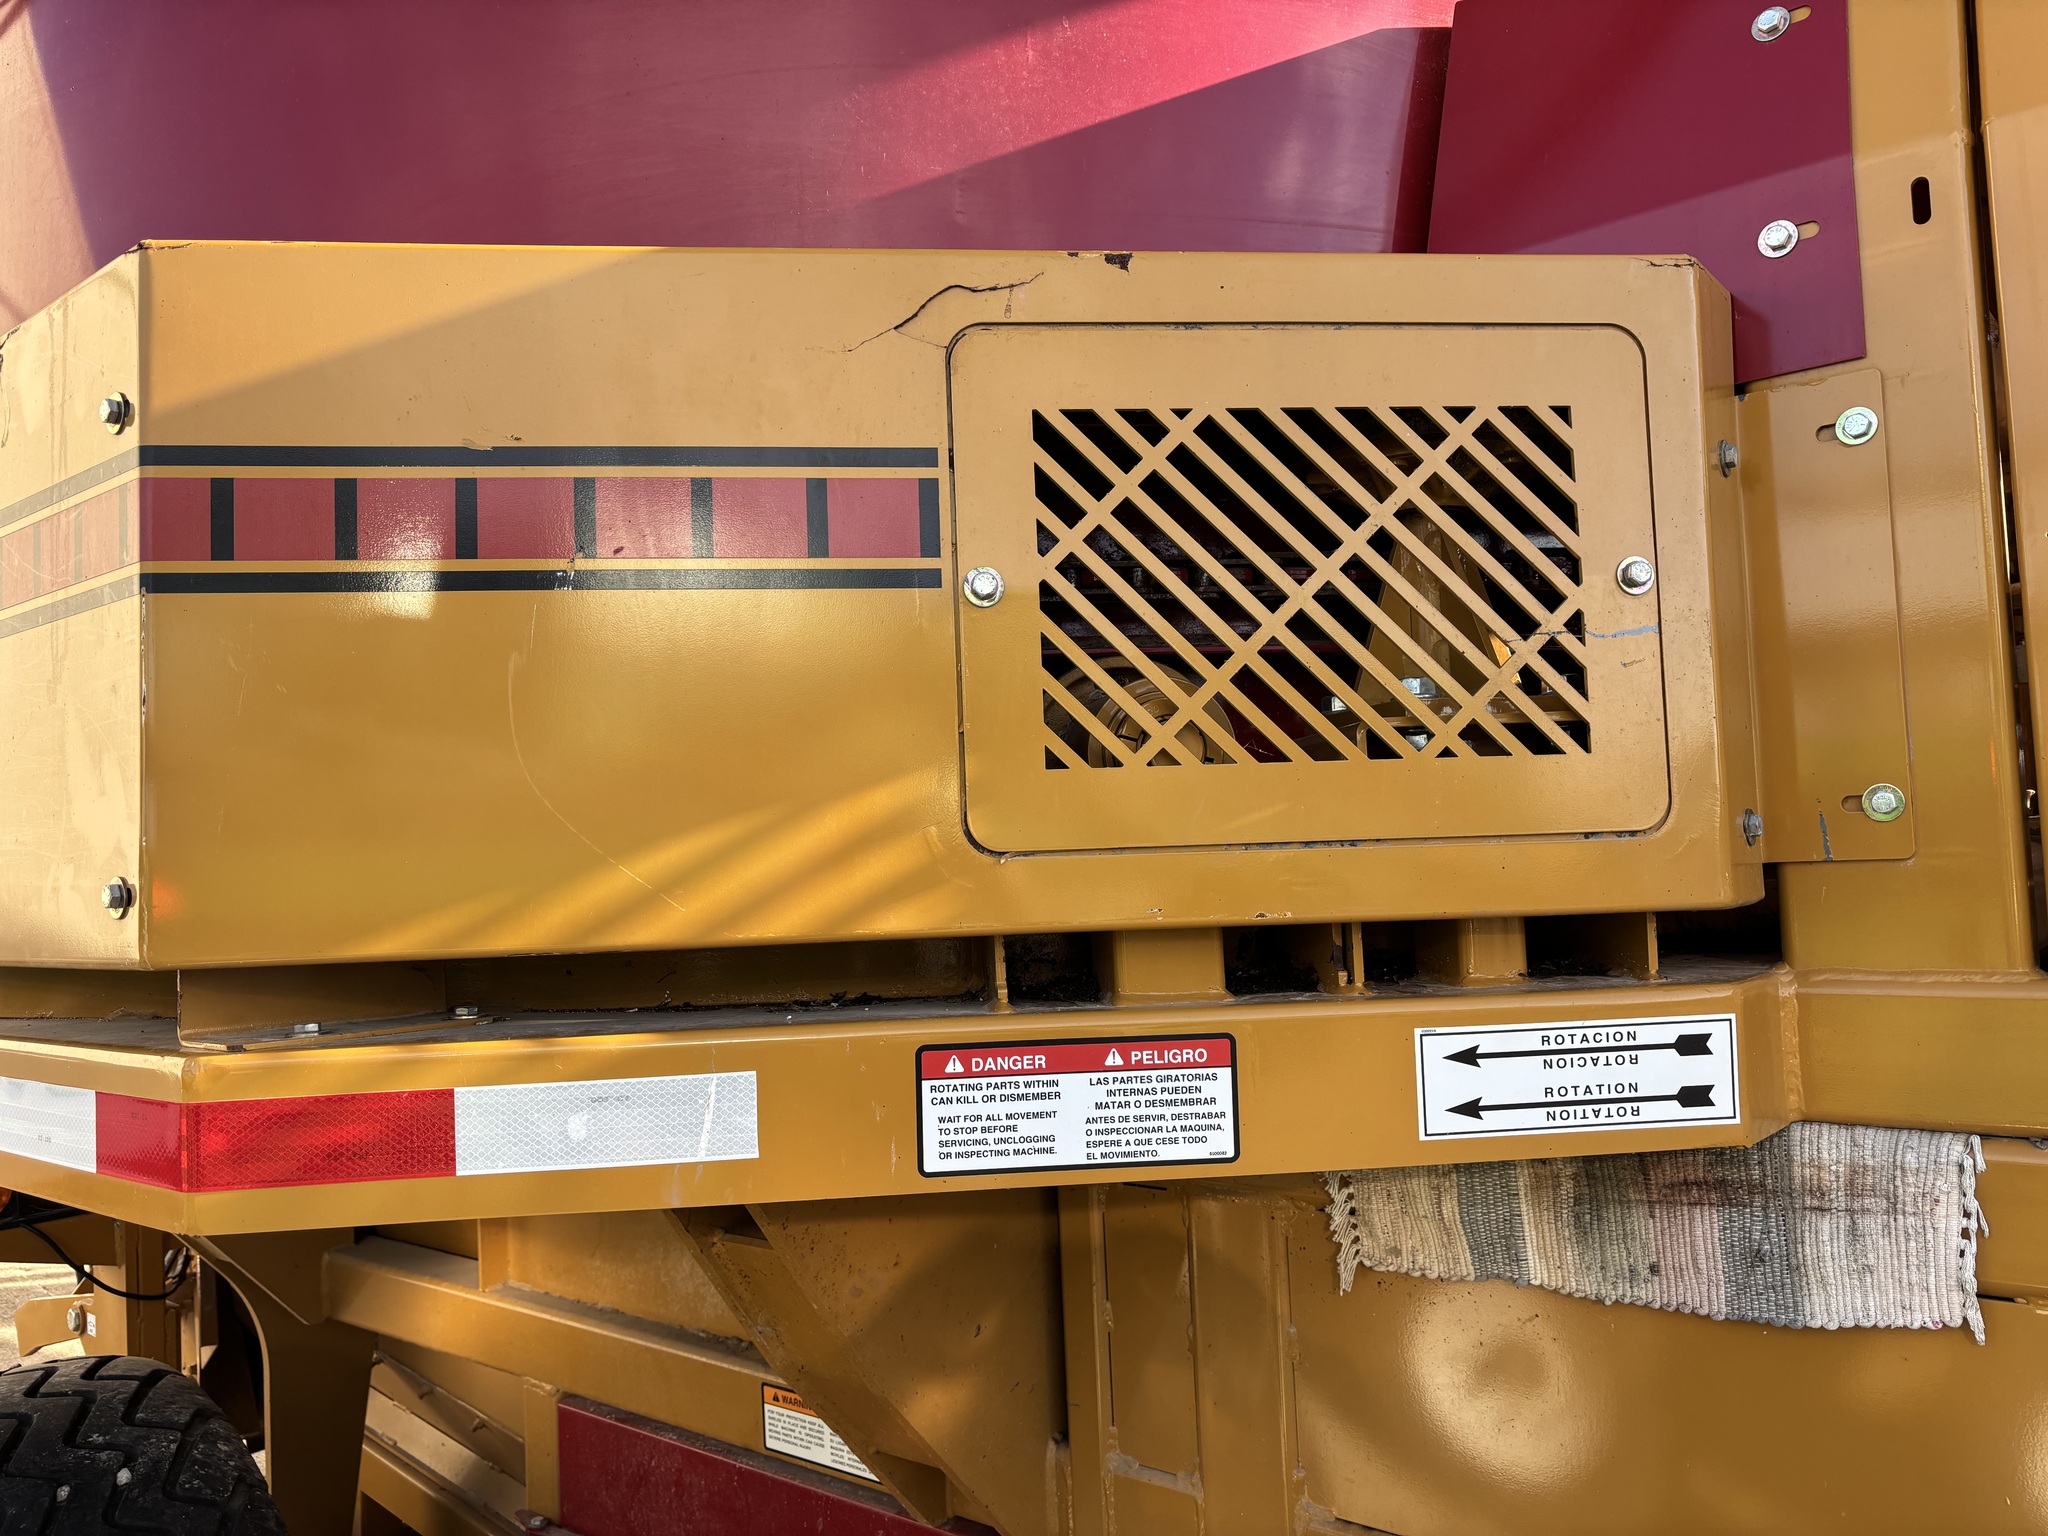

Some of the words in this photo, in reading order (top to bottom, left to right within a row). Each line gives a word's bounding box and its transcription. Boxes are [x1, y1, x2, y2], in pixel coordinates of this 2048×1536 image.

[1541, 1030, 1636, 1046] ROTACION
[971, 1054, 1046, 1072] DANGER
[1130, 1048, 1208, 1065] PELIGRO
[1543, 1054, 1638, 1070] ROTACION
[1089, 1077, 1110, 1086] LAS
[1112, 1075, 1153, 1085] PARTES
[1155, 1072, 1218, 1083] GIRATORIAS
[930, 1082, 983, 1094] ROTATING
[986, 1080, 1020, 1090] PARTS
[1022, 1079, 1059, 1088] WITHIN
[1106, 1087, 1158, 1097] INTERNAS
[1160, 1086, 1202, 1095] PUEDEN
[1544, 1082, 1638, 1098] ROTATION
[931, 1096, 953, 1106] CAN
[956, 1096, 979, 1104] KILL
[982, 1094, 996, 1103] OR
[1000, 1092, 1061, 1102] DISMEMBER
[1094, 1100, 1131, 1110] MATAR
[1134, 1100, 1142, 1108] O
[1144, 1097, 1217, 1108] DESMEMBRAR
[938, 1116, 962, 1124] WAIT
[964, 1114, 983, 1122] FOR
[985, 1114, 1003, 1122] ALL
[1005, 1111, 1058, 1120] MOVEMENT
[1085, 1116, 1116, 1124] ANTES
[1118, 1115, 1131, 1123] DE
[1132, 1114, 1168, 1122] SERVIR,
[1170, 1111, 1226, 1121] DESTRABAR
[1546, 1106, 1640, 1122] ROTATION
[938, 1128, 951, 1136] TO
[953, 1126, 978, 1135] STOP
[980, 1124, 1018, 1134] BEFORE
[1085, 1128, 1093, 1137] O
[1094, 1126, 1164, 1136] INSPECCIONAR
[1180, 1123, 1224, 1132] MAQUINA,
[938, 1138, 991, 1148] SERVICING,
[993, 1134, 1056, 1145] UNCLOGGING
[1086, 1139, 1122, 1148] ESPERE
[1134, 1138, 1153, 1146] QUE
[1155, 1137, 1180, 1145] CESE
[1182, 1136, 1208, 1144] TODO
[938, 1152, 952, 1160] OR
[955, 1149, 1010, 1159] INSPECTING
[1013, 1146, 1057, 1156] MACHINE.
[1100, 1150, 1160, 1160] MOVIMIENTO.
